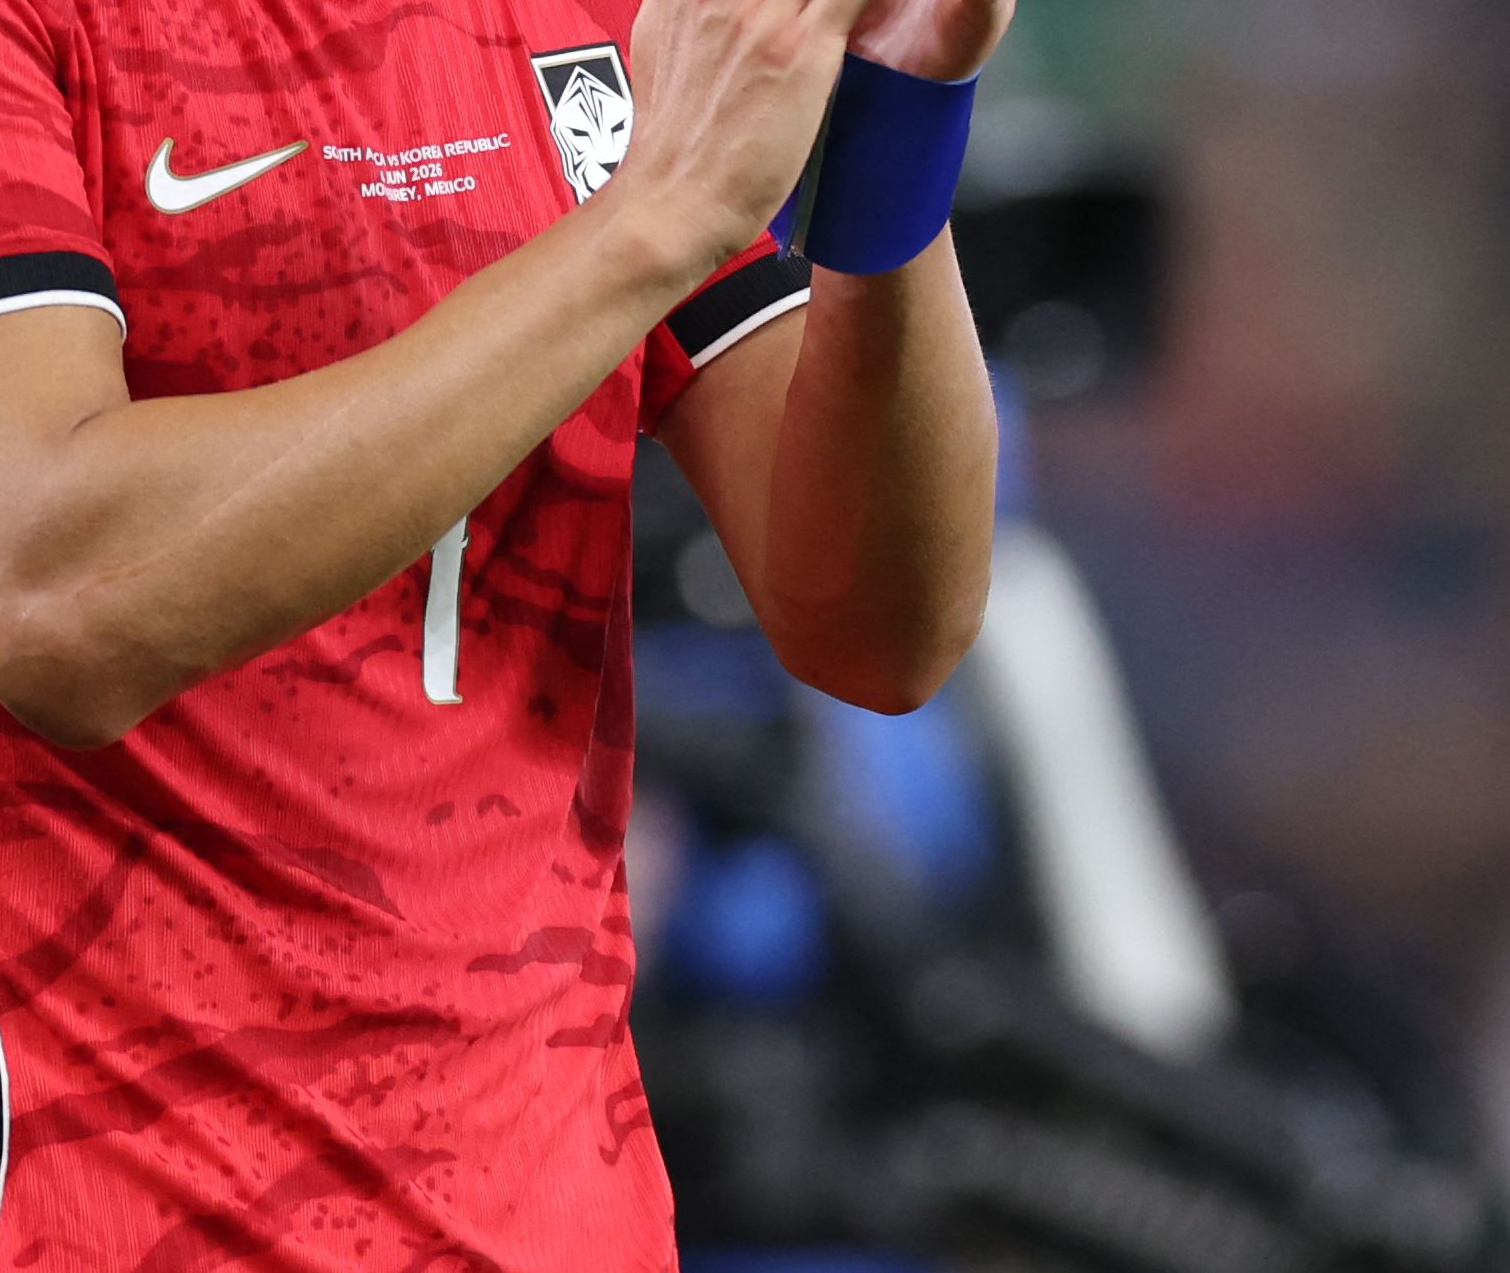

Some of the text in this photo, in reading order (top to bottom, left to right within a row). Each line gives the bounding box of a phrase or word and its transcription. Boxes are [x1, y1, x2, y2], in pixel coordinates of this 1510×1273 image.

[399, 144, 443, 166] KOREA
[443, 133, 511, 157] REPUBLIC
[409, 163, 443, 181] 2026
[424, 176, 476, 197] MEXICO
